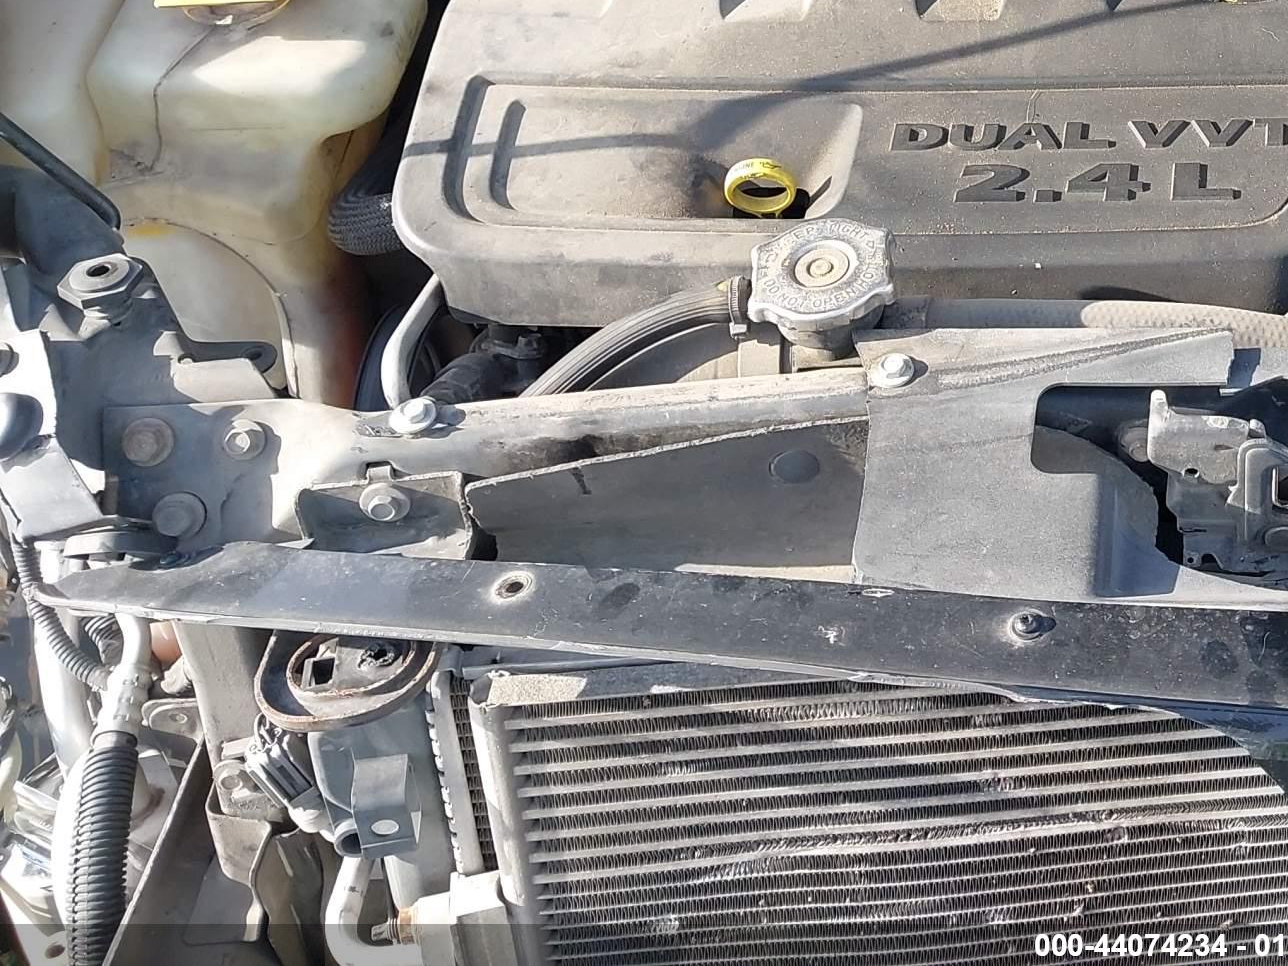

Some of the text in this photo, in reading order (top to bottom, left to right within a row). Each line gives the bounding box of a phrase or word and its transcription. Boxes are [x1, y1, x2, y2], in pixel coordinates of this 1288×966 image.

[889, 121, 1116, 151] DUAL
[828, 221, 870, 241] TIGHT
[812, 287, 857, 309] OPEN
